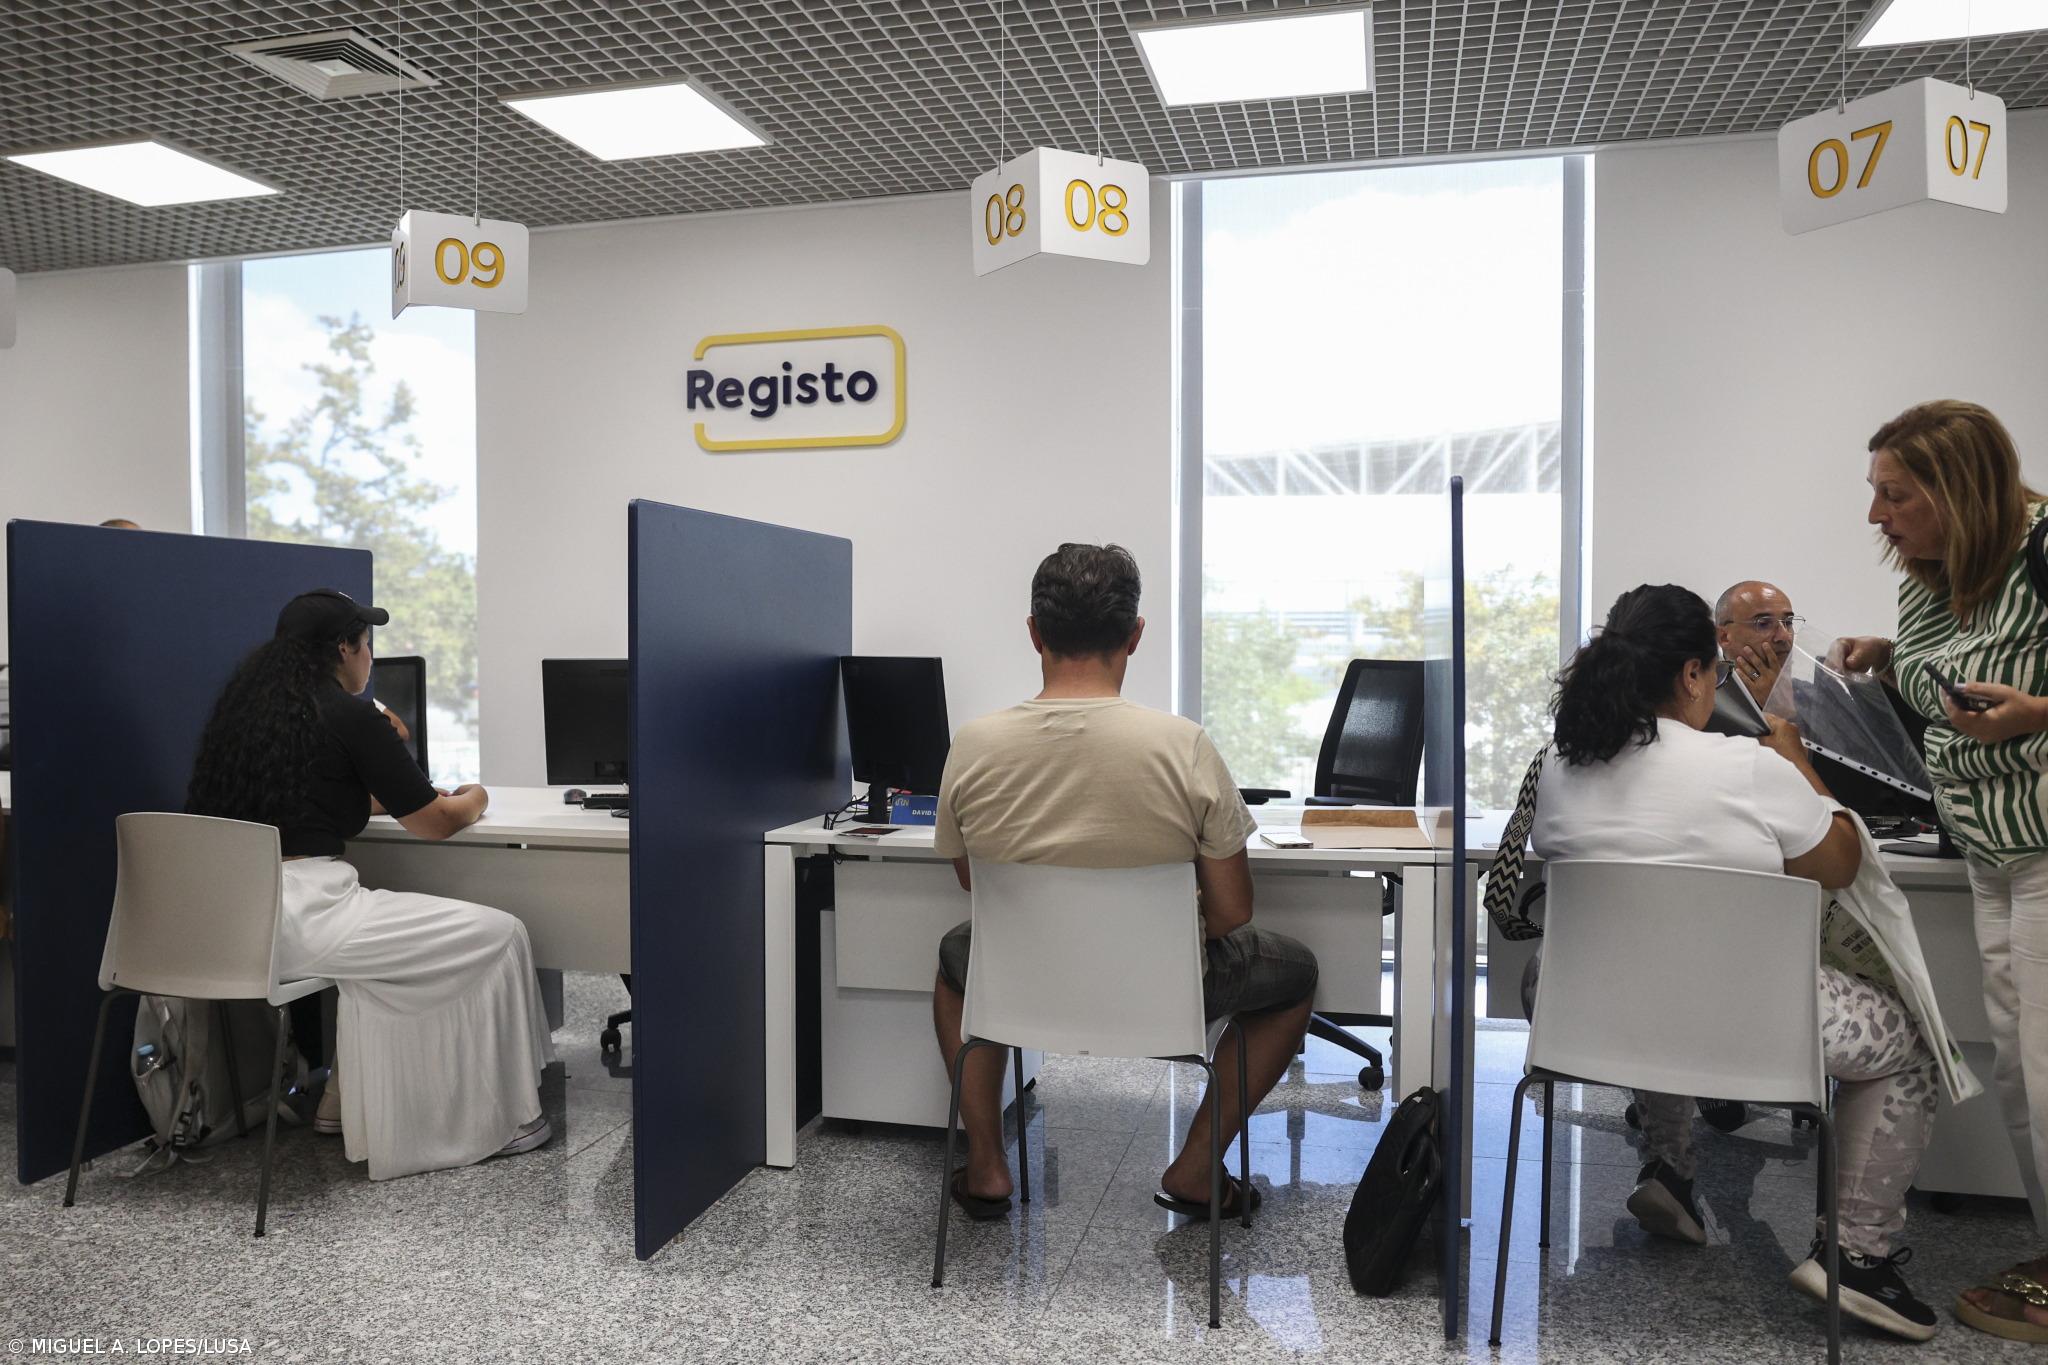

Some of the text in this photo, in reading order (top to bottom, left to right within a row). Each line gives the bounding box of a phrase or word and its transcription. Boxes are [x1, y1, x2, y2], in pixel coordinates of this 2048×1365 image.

[1808, 120, 1893, 199] 07
[1945, 115, 1991, 180] 07
[985, 183, 1026, 246] 08
[1064, 178, 1129, 237] 08
[434, 237, 506, 289] 09
[686, 361, 878, 418] Registo
